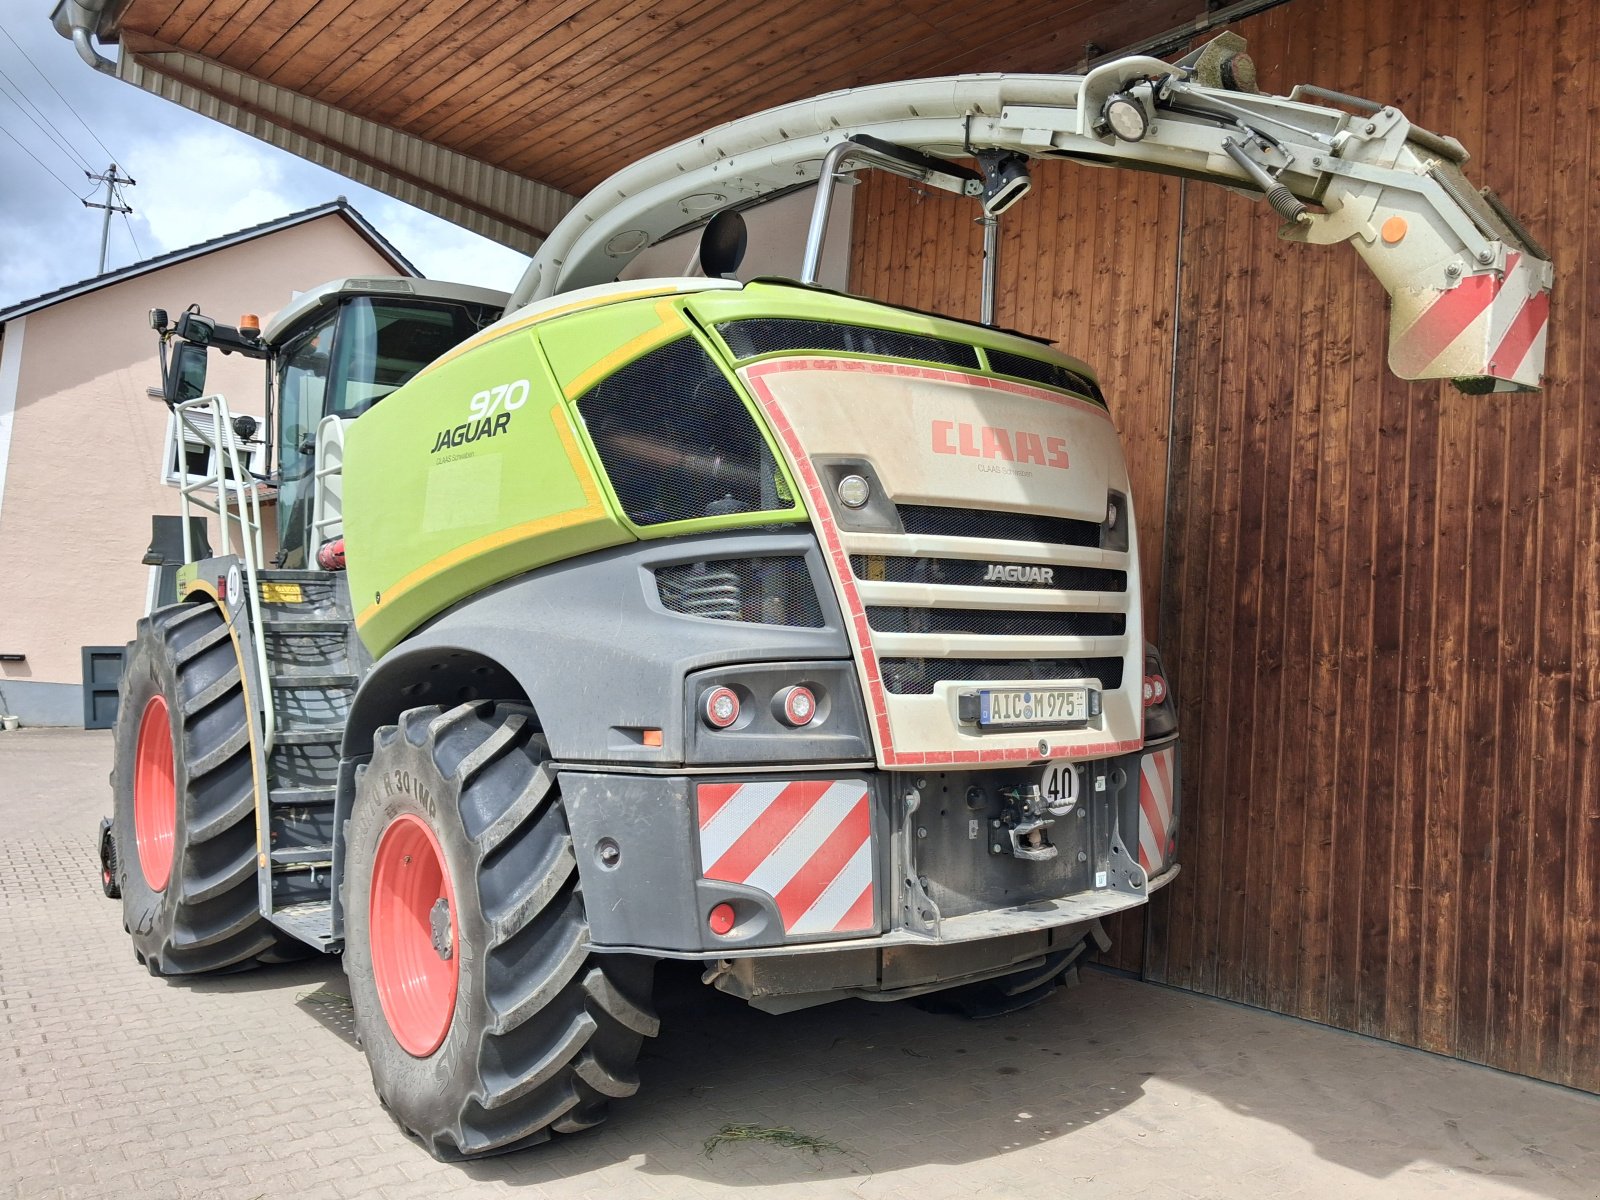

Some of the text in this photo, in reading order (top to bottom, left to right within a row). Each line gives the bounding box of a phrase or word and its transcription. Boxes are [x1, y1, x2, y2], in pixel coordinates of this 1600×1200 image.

[468, 379, 530, 423] 970
[430, 412, 511, 454] JAGUAR
[931, 420, 1070, 470] CLAAS
[436, 454, 451, 465] CLAAS
[977, 464, 1001, 474] CLAAS
[983, 564, 1054, 584] JAGUAR
[992, 692, 1075, 719] AIC M 975
[395, 769, 411, 795] 30
[1048, 767, 1072, 801] 40
